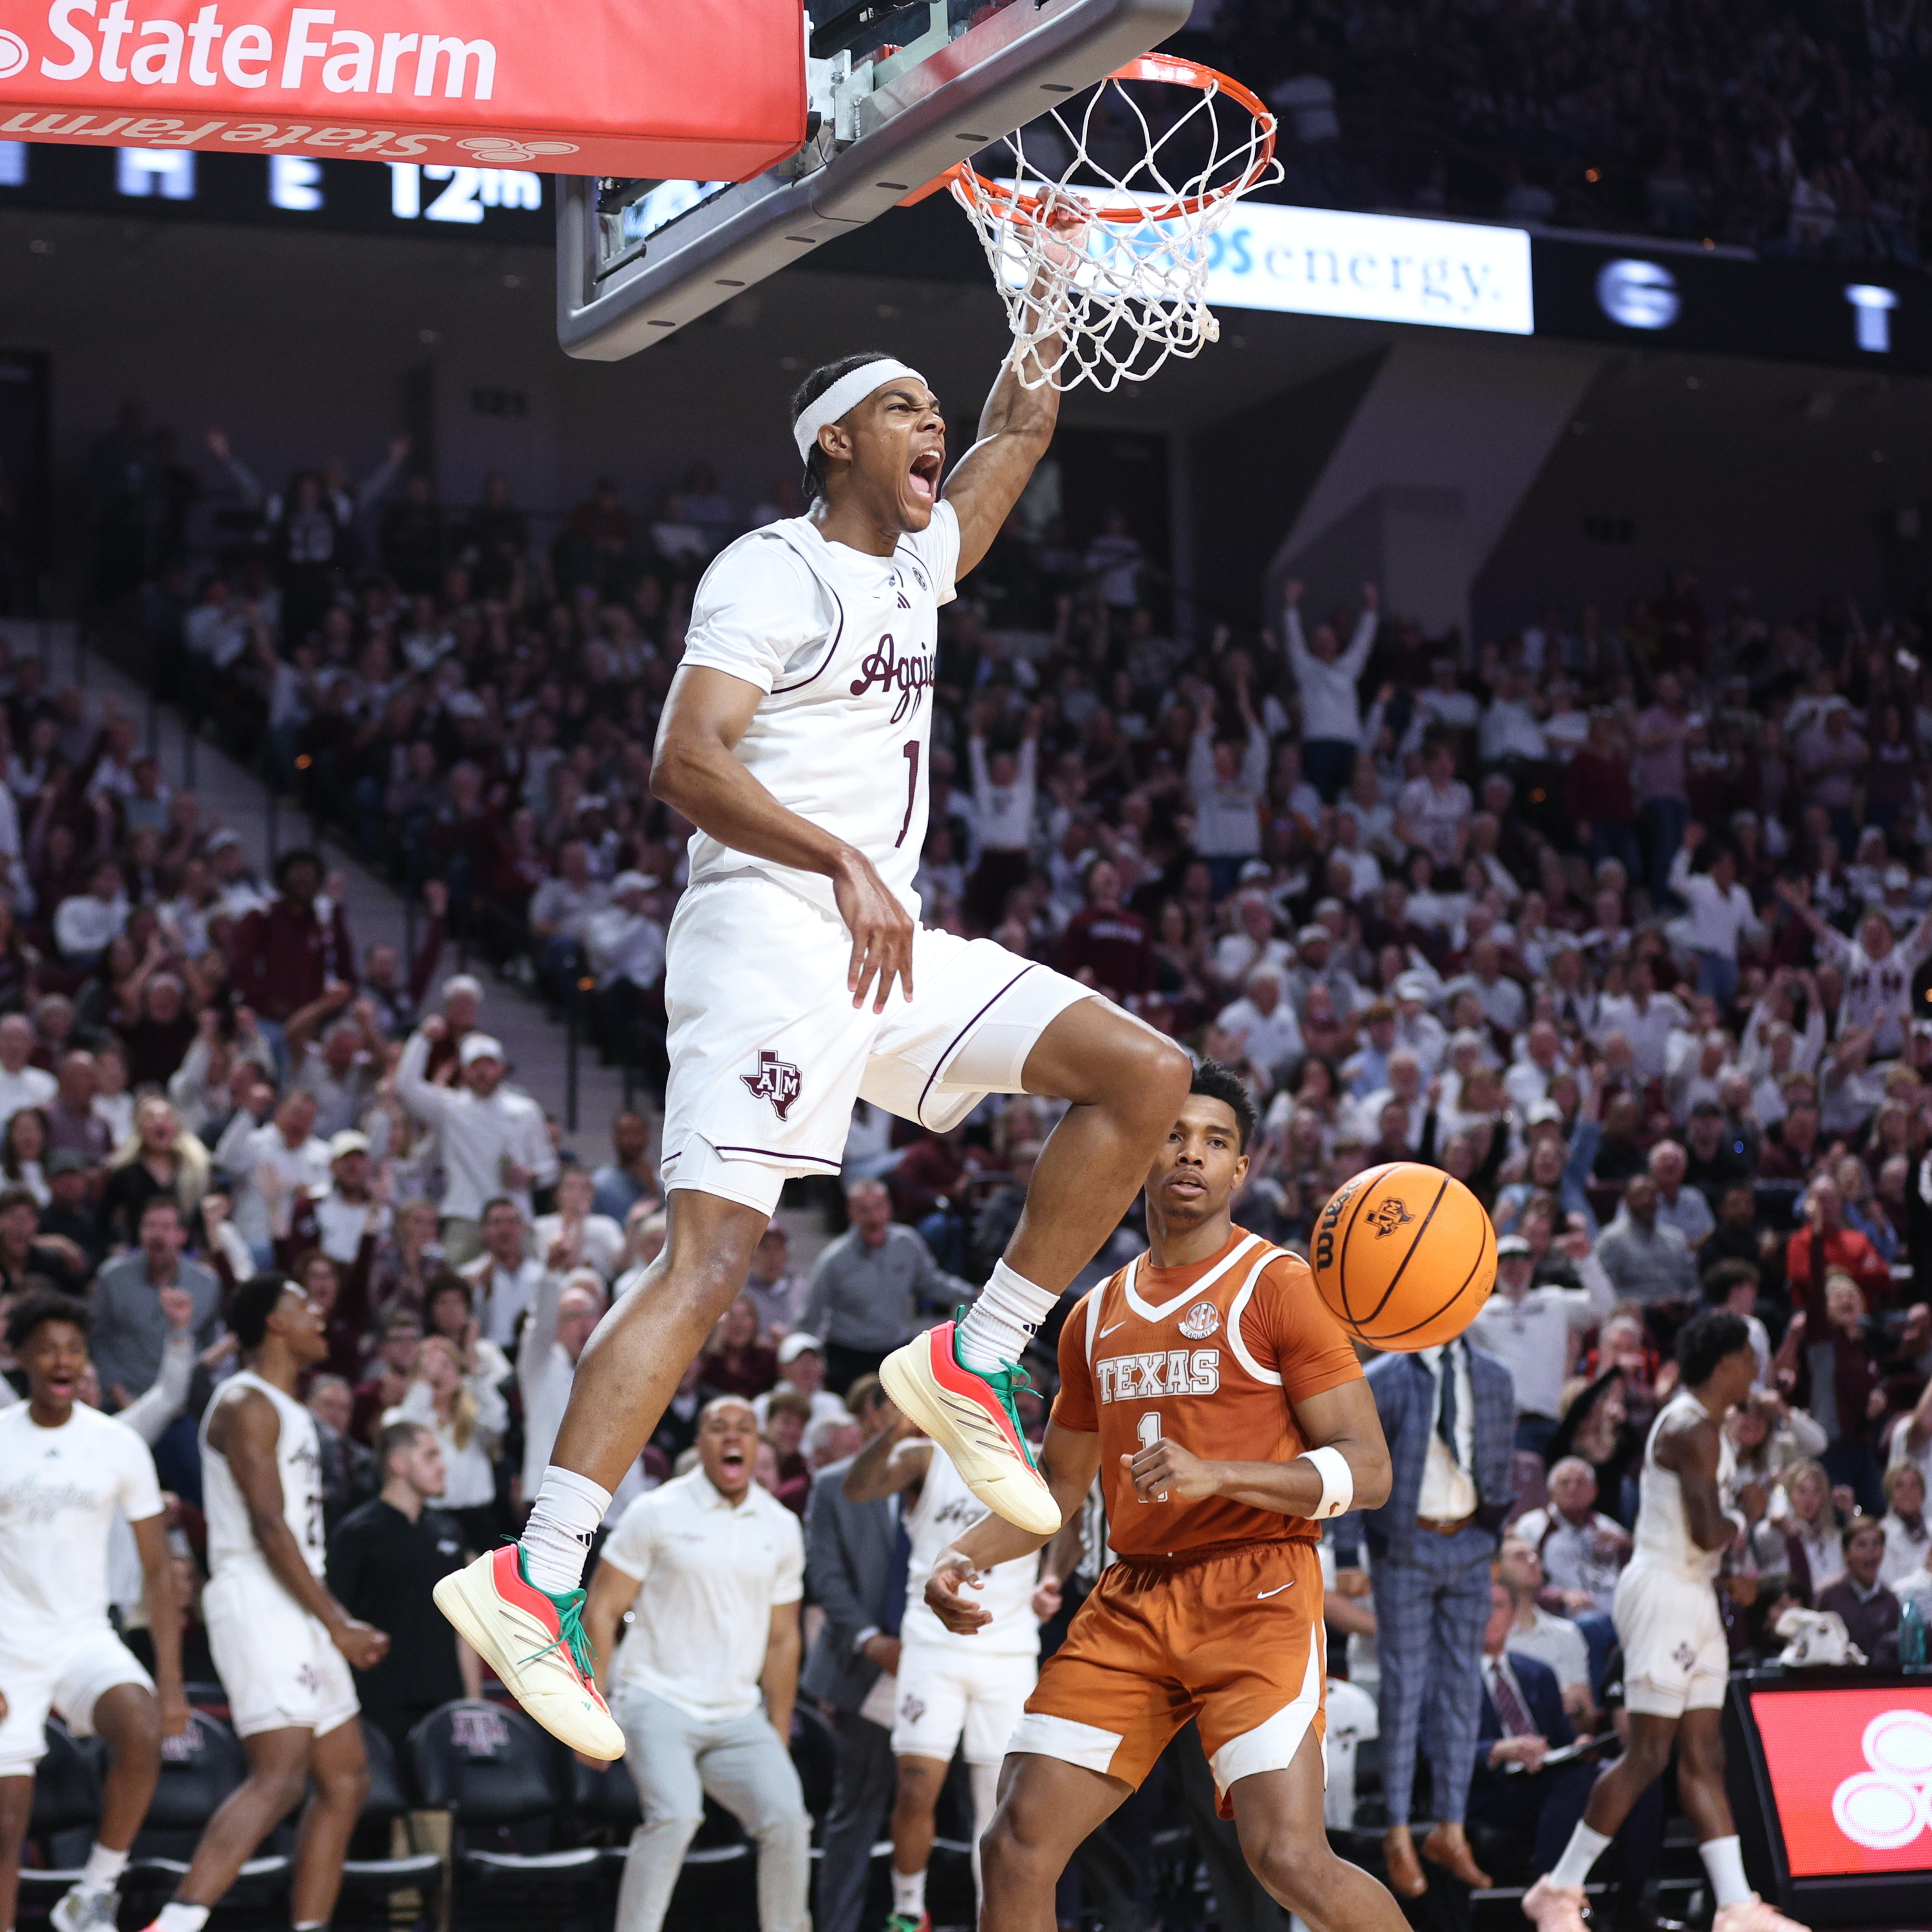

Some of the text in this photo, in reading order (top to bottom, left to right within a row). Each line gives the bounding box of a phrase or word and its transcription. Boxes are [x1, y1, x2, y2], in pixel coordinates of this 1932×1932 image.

[850, 633, 935, 724] Aggie
[895, 739, 920, 849] 1
[1181, 1327, 1214, 1340] GRADUATE
[1188, 1303, 1216, 1331] SEC
[1096, 1349, 1220, 1405] TEXAS
